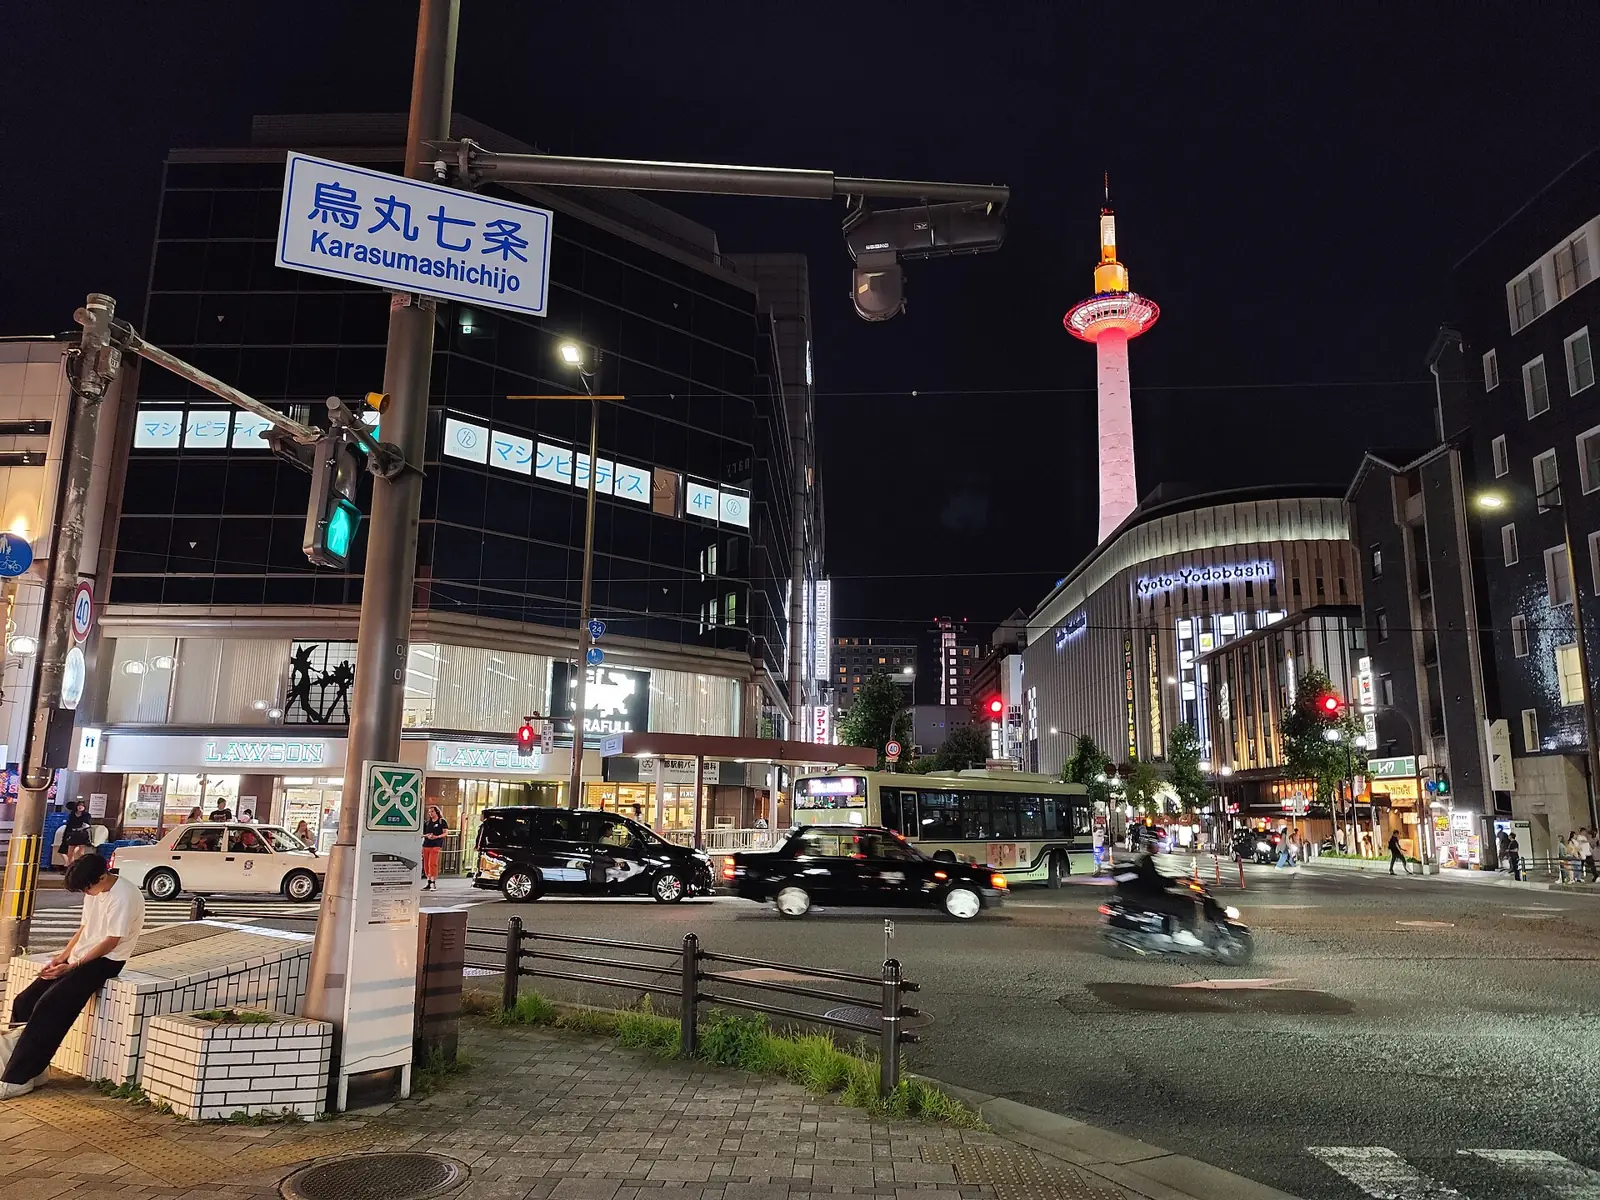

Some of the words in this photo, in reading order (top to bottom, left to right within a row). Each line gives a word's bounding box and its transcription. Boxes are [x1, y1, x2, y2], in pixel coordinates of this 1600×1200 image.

[307, 181, 529, 263] 烏丸七条
[310, 229, 521, 294] Karasumashichijo
[494, 439, 643, 494] マシンピラティス
[692, 493, 713, 510] 4F
[1135, 562, 1271, 594] Kyoto-Yodobashi
[76, 597, 90, 626] 40
[816, 586, 827, 655] ENTERTAINMENT
[592, 625, 602, 633] 24
[205, 742, 325, 764] LAWSON
[435, 745, 541, 770] LAWSON
[888, 745, 898, 753] 40
[139, 784, 160, 793] ATM
